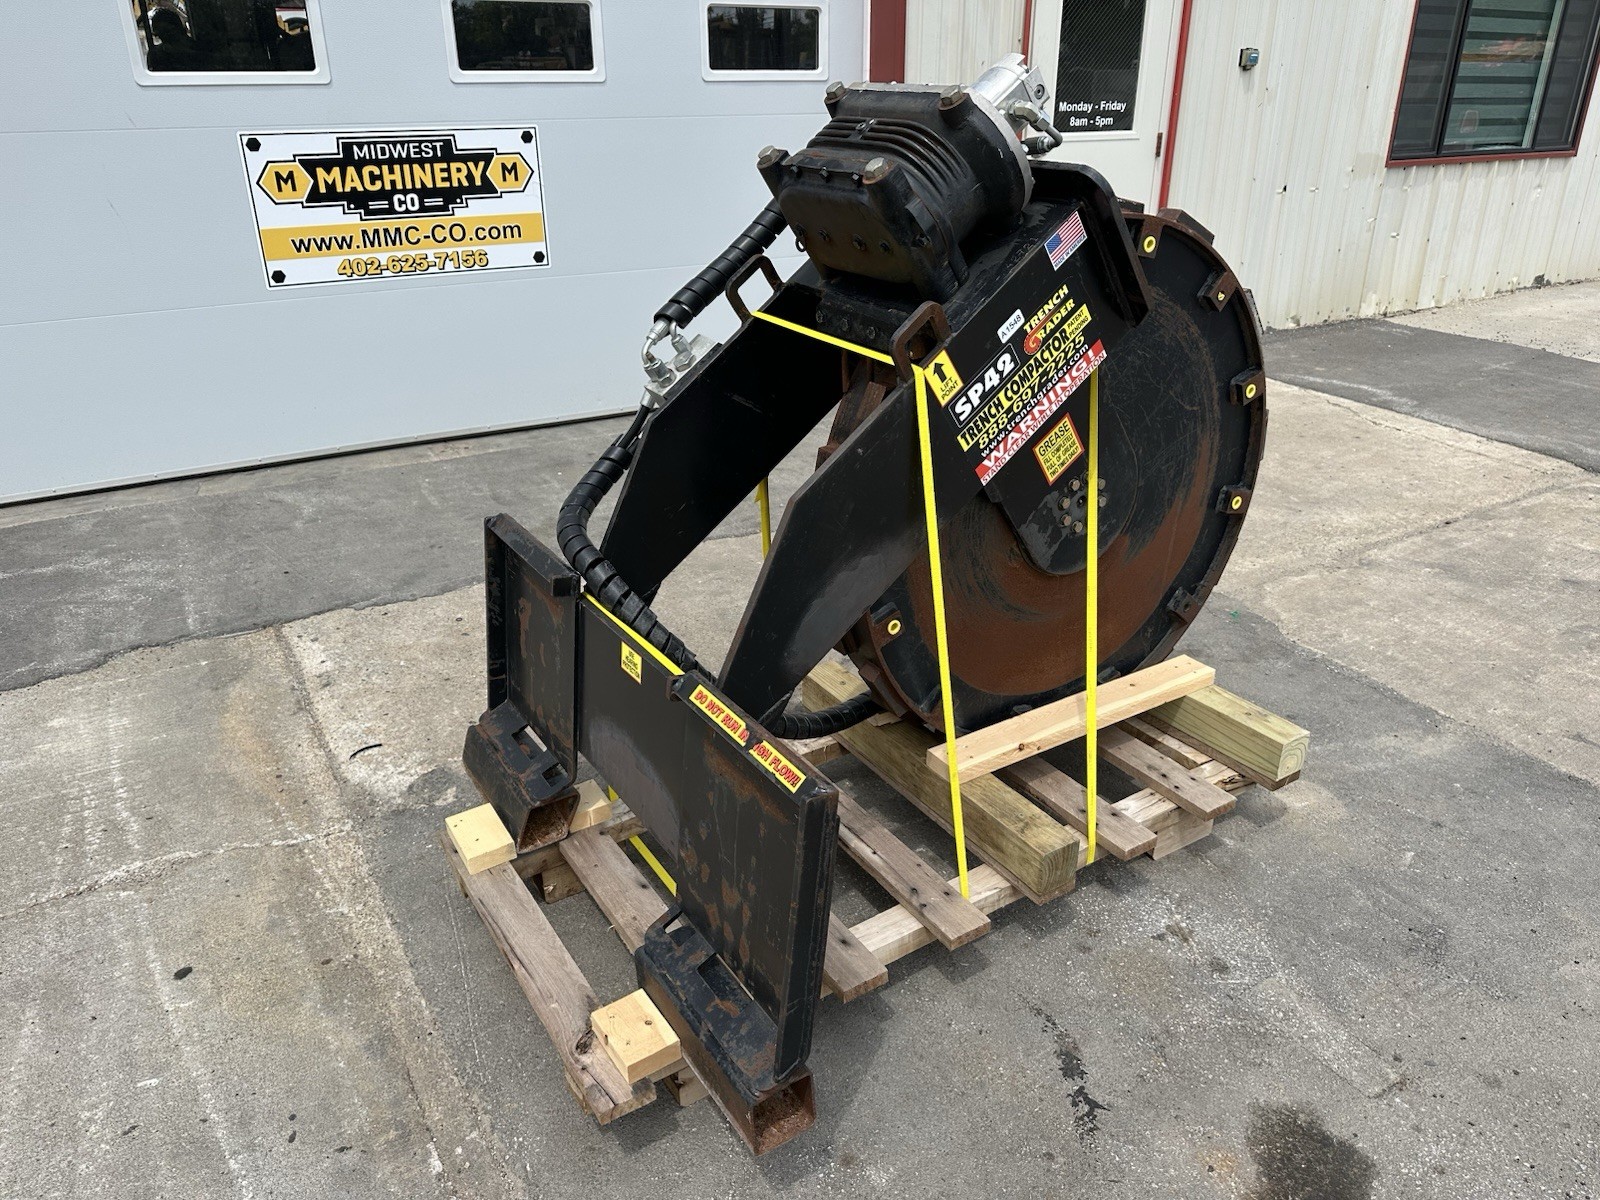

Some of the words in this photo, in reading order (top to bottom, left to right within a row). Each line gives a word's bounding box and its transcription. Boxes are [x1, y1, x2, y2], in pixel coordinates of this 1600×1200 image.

[1059, 101, 1093, 113] Monday
[1100, 100, 1126, 112] Friday
[1070, 116, 1087, 126] 8am
[1095, 116, 1113, 127] 5pm
[353, 142, 443, 160] MIDWEST
[274, 171, 297, 192] M
[316, 161, 485, 193] MACHINERY
[501, 162, 519, 182] M
[393, 193, 420, 212] CO
[290, 223, 522, 253] www.MMC-CO.com
[337, 249, 489, 277] 402-625-7156
[1023, 284, 1069, 333] TRENCH
[1028, 298, 1075, 348] GRADER
[1066, 309, 1084, 329] PATENT
[1068, 316, 1089, 338] PENDING
[940, 377, 953, 393] LIFT
[941, 380, 959, 400] POINT
[954, 352, 1015, 422] SP42
[960, 395, 1004, 447] TRENCH
[1003, 328, 1071, 402] COMPACTOR
[979, 331, 1085, 449] 888-697-2225
[981, 343, 1089, 458] www.trenchgrader.com
[982, 348, 1095, 468] WARNING!
[982, 457, 1007, 484] STAND
[1007, 431, 1030, 457] CLEAR
[1030, 407, 1054, 432] WHILE
[1055, 396, 1064, 407] IN
[1063, 352, 1105, 398] OPERATION
[1038, 420, 1070, 457] GREASE
[694, 689, 708, 705] DO
[705, 699, 725, 719] NOT
[721, 713, 742, 734] RUN
[738, 728, 750, 743] IN
[752, 742, 773, 762] IGH
[768, 755, 801, 788] FLOW!!
